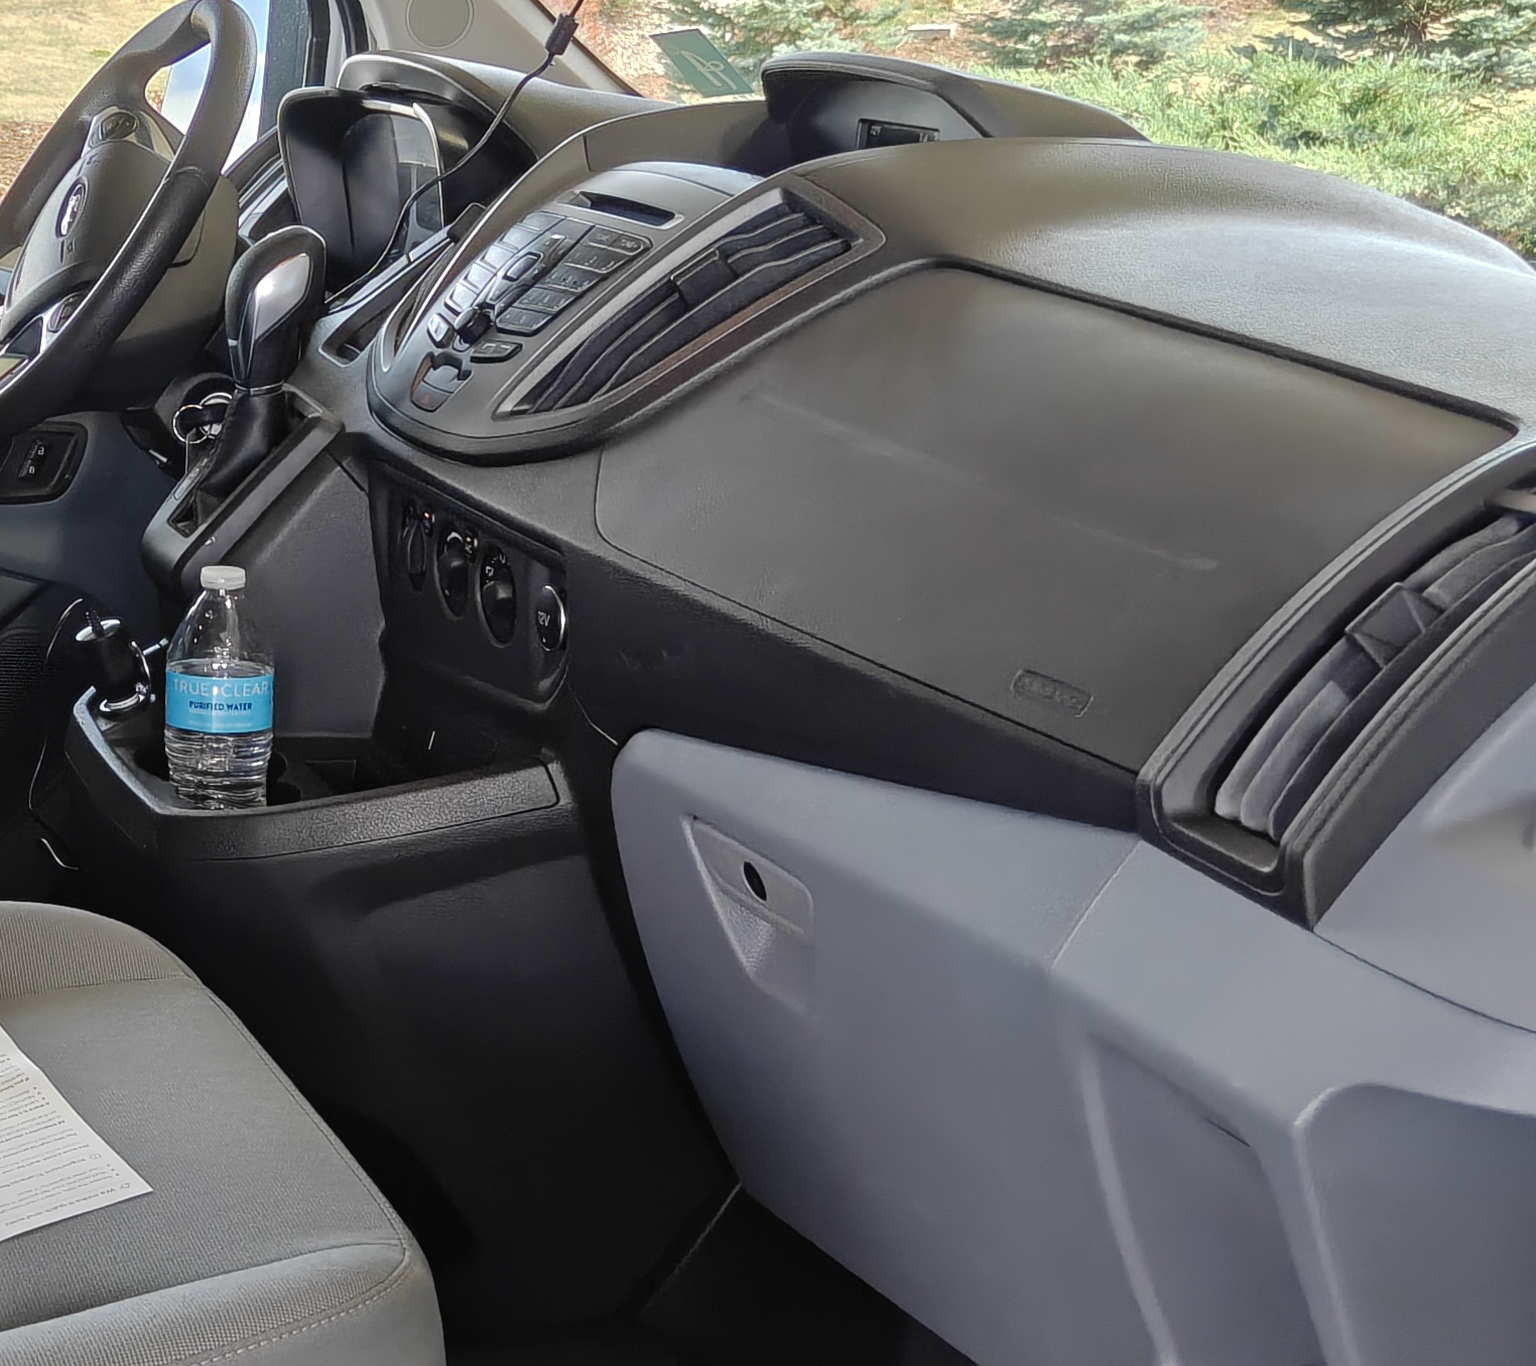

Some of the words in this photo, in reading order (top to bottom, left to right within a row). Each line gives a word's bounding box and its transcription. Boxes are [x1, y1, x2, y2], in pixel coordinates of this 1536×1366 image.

[173, 678, 210, 697] TRUE
[221, 681, 269, 698] CLEAR
[189, 700, 225, 711] PURIFIED
[227, 702, 253, 711] WATER
